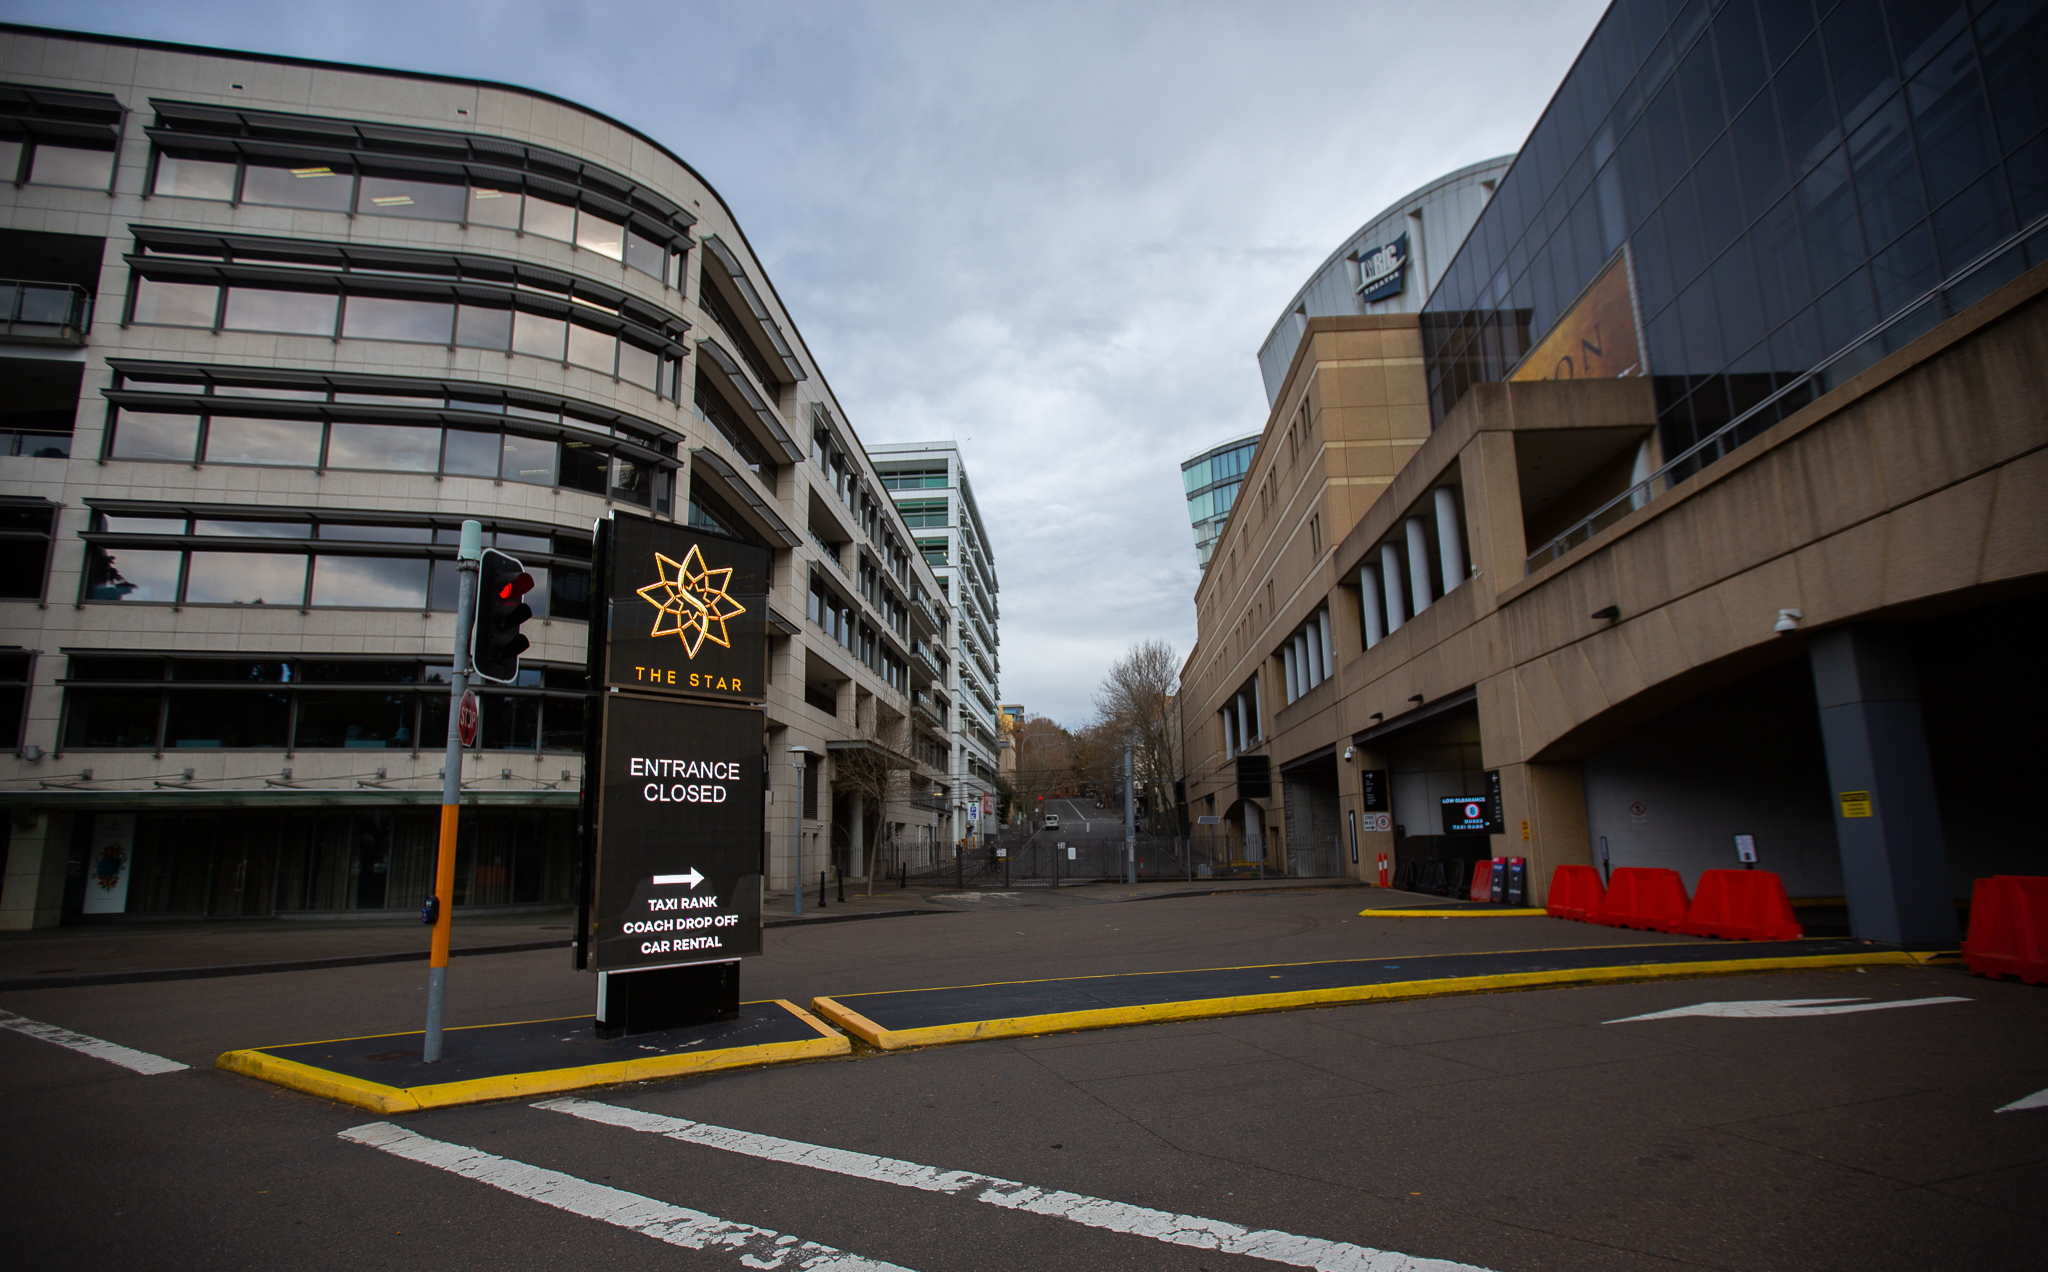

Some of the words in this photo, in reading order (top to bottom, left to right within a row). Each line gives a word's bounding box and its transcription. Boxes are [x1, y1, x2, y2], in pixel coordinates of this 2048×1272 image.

[1364, 271, 1400, 295] THEATRE
[635, 666, 676, 685] THE
[689, 673, 742, 692] STAR
[460, 706, 476, 729] STOP
[630, 757, 741, 780] ENTRANCE
[643, 783, 727, 803] CLOSED
[1454, 796, 1486, 804] CLEARANCE
[1381, 818, 1387, 826] 8
[647, 897, 678, 911] TAXI
[680, 895, 718, 910] RANK
[623, 918, 673, 934] COACH
[676, 916, 712, 931] DROP
[714, 915, 739, 927] OFF
[640, 940, 671, 954] CAR
[673, 936, 723, 952] RENTAL
